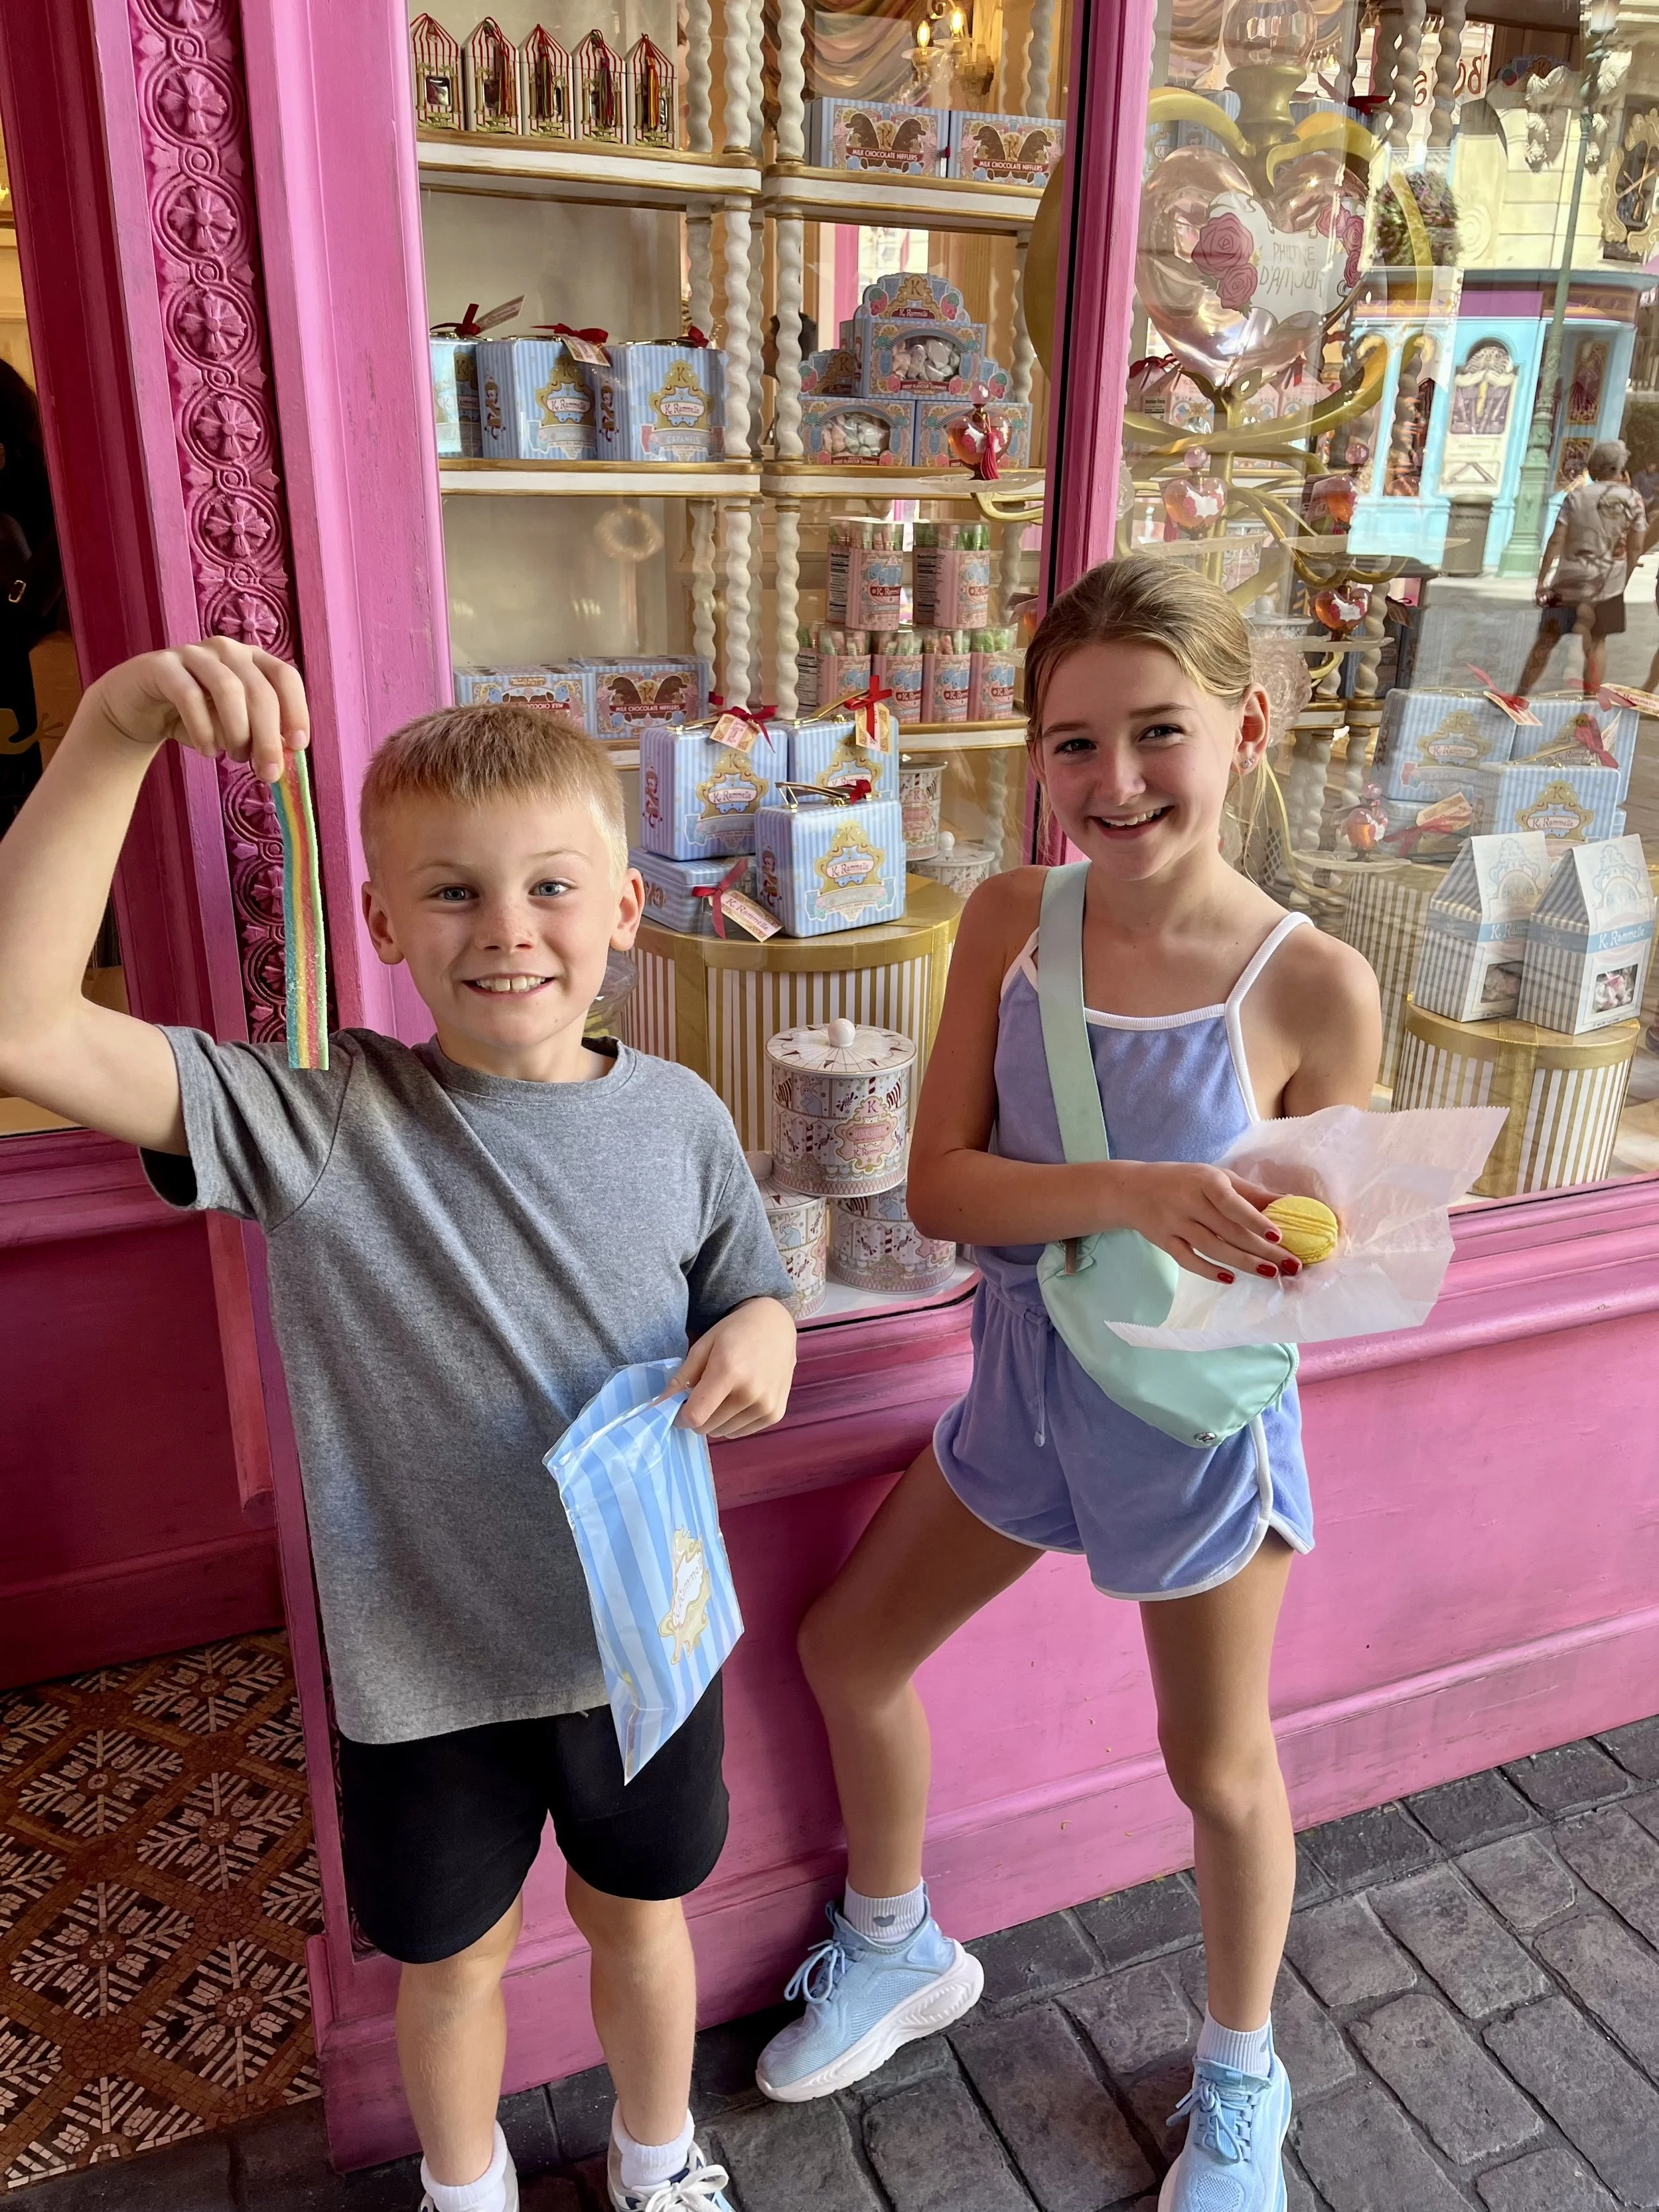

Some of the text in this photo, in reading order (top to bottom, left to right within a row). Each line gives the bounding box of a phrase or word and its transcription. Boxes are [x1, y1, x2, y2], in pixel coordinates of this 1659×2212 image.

[865, 151, 895, 159] CHOCOLATE
[910, 280, 922, 295] K
[457, 360, 469, 374] K
[563, 362, 574, 378] K
[840, 357, 849, 372] K
[677, 367, 688, 382] K
[729, 753, 744, 769] K
[1553, 786, 1564, 800] K
[1543, 818, 1573, 827] Rammelle
[845, 827, 855, 841] K
[841, 863, 869, 874] Rammelle
[735, 903, 768, 930] Rammelle
[1490, 924, 1501, 940] K.
[1599, 924, 1644, 949] K. Rammelle
[867, 1100, 879, 1113] K
